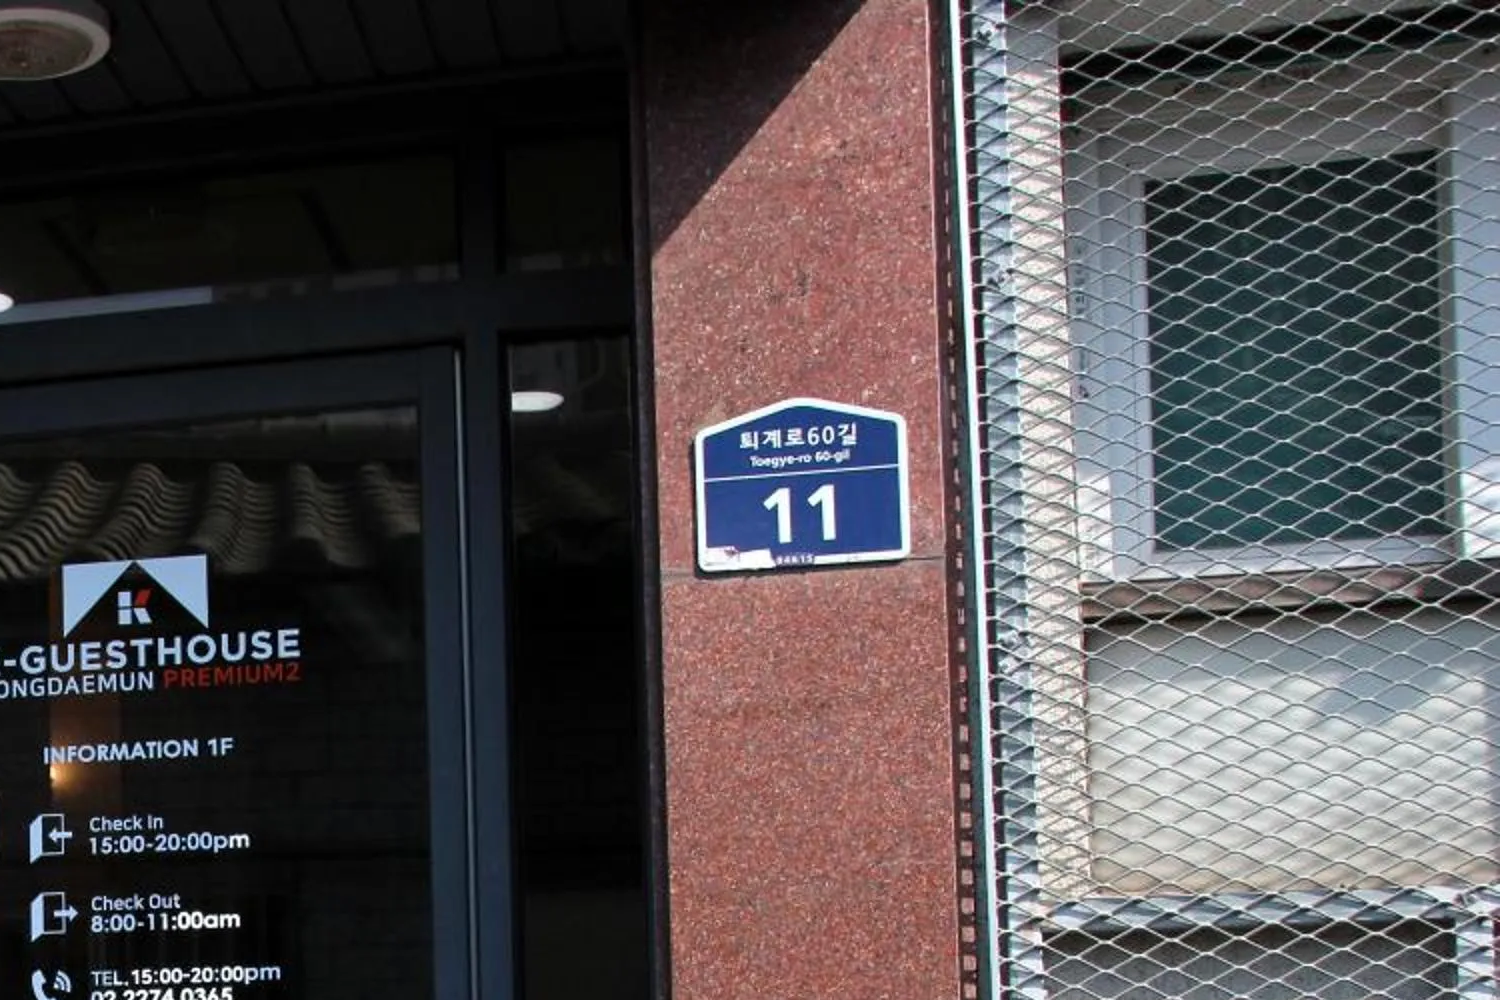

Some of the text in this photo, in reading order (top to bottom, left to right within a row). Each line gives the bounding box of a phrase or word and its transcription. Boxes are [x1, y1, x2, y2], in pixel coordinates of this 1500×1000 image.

[740, 422, 858, 450] 퇴계로60길
[750, 448, 851, 469] Toegye-ro 60-gil
[763, 484, 836, 544] 11
[163, 662, 301, 689] PREMIUM2
[43, 737, 234, 765] INFORMATION 1F
[89, 814, 164, 832] Check In
[89, 832, 250, 855] 15:00-20:00pm
[91, 893, 181, 911] Check Out
[91, 911, 241, 933] 8:00-11:00am
